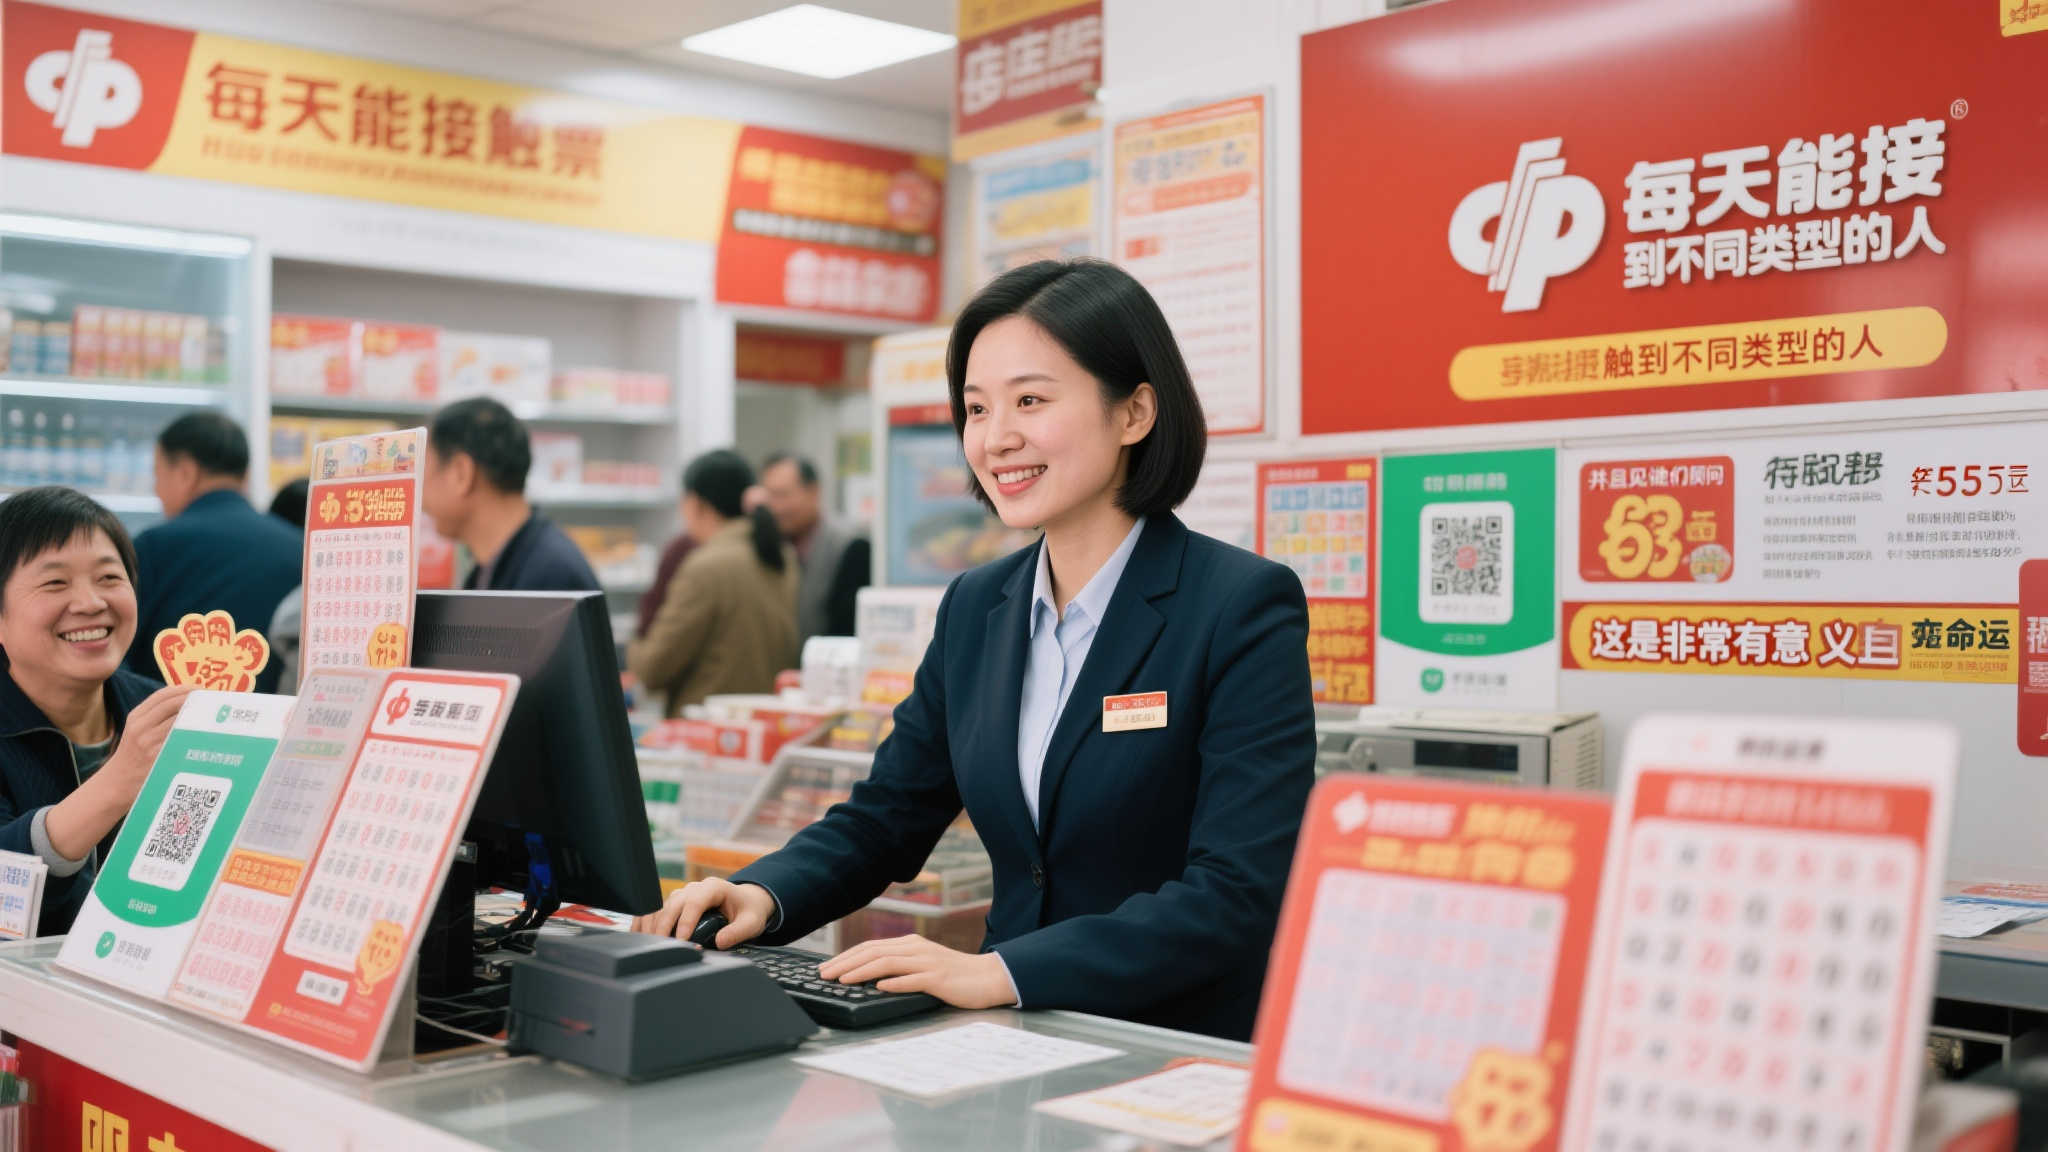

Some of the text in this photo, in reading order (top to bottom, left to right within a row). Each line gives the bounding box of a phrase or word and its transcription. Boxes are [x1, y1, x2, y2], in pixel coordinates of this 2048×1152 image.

[1623, 118, 1946, 234] 每天能接
[1623, 205, 1946, 289] 到不同类型的人
